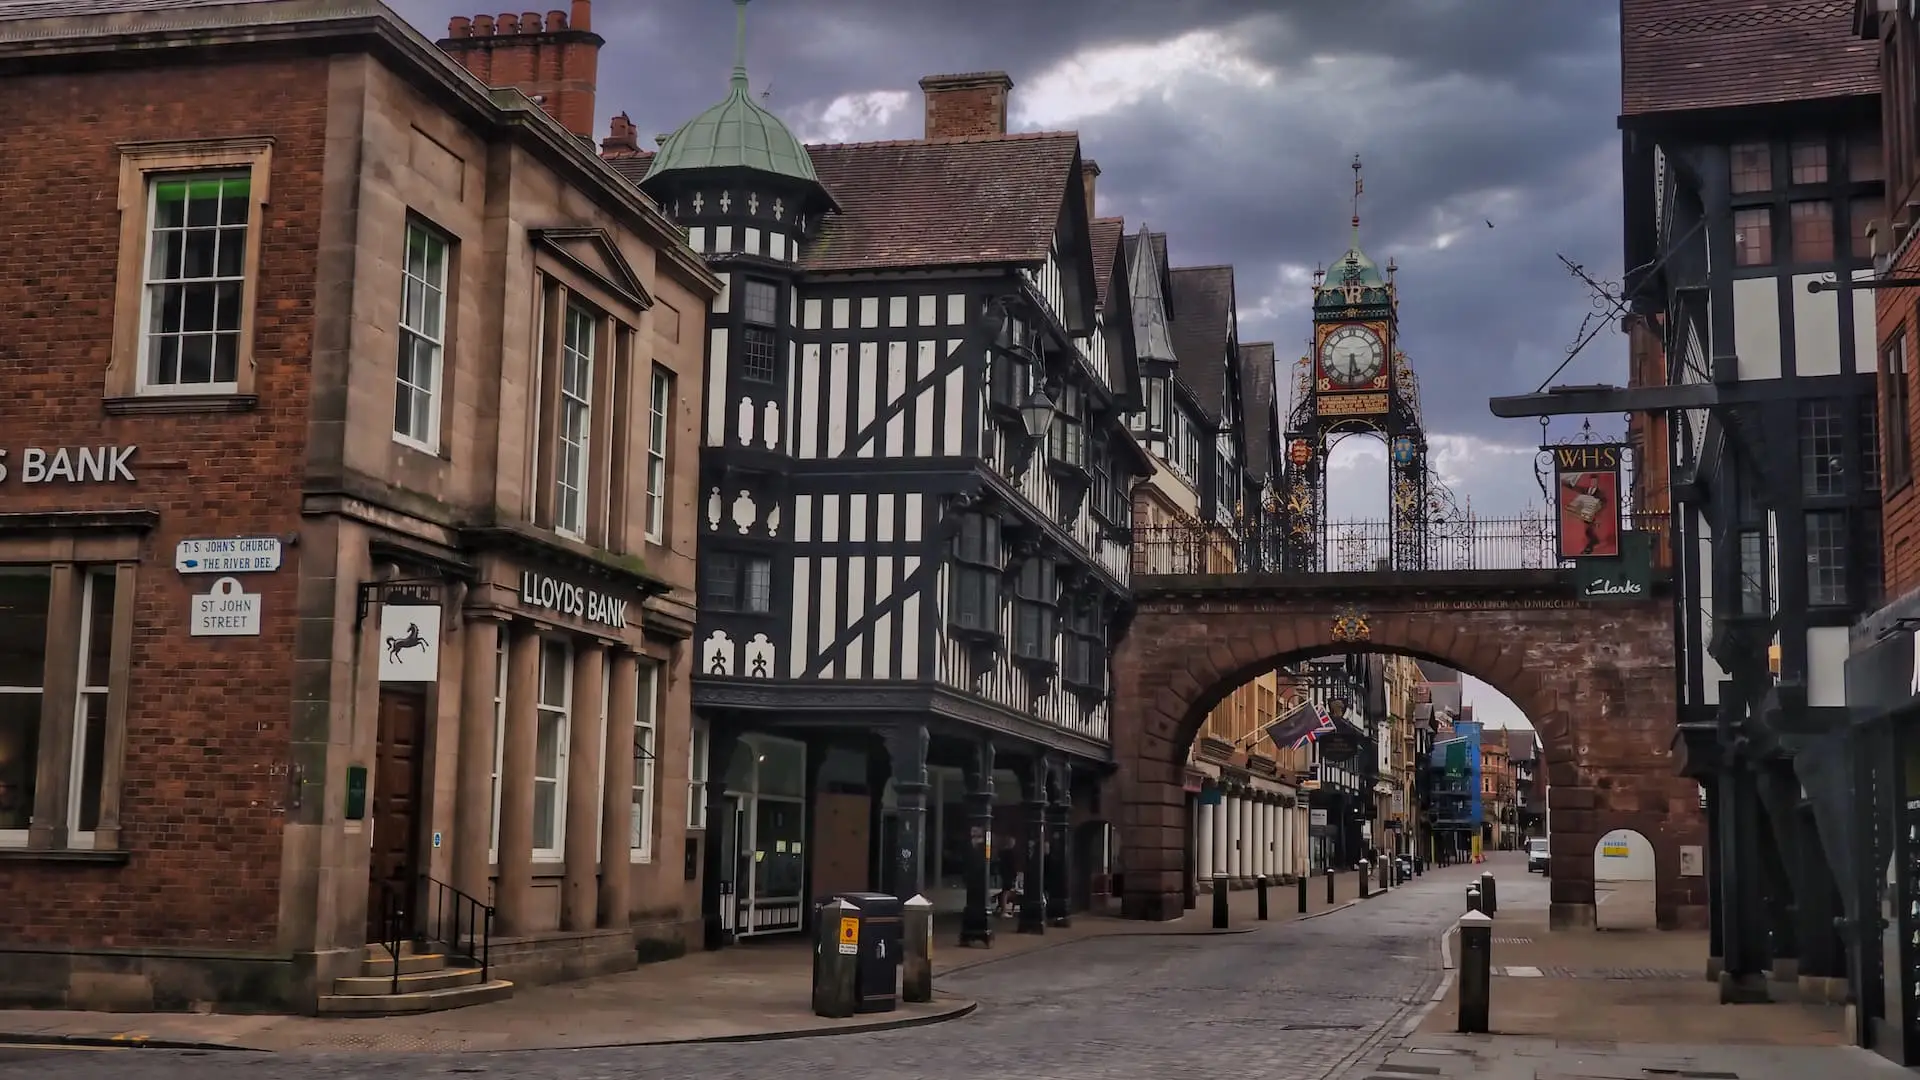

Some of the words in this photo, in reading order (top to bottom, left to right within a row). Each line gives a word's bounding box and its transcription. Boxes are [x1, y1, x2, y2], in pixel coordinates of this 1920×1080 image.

[1318, 378, 1331, 391] 18
[1373, 376, 1387, 388] 97
[22, 446, 137, 482] BANK
[240, 540, 275, 552] CHURCH
[203, 558, 219, 569] THE
[223, 558, 250, 569] RIVER
[1585, 579, 1641, 595] Clarks
[201, 600, 216, 612] ST
[220, 600, 252, 613] JOHN
[524, 571, 584, 617] LLOYDS
[587, 590, 628, 629] BANK
[203, 616, 248, 628] STREET
